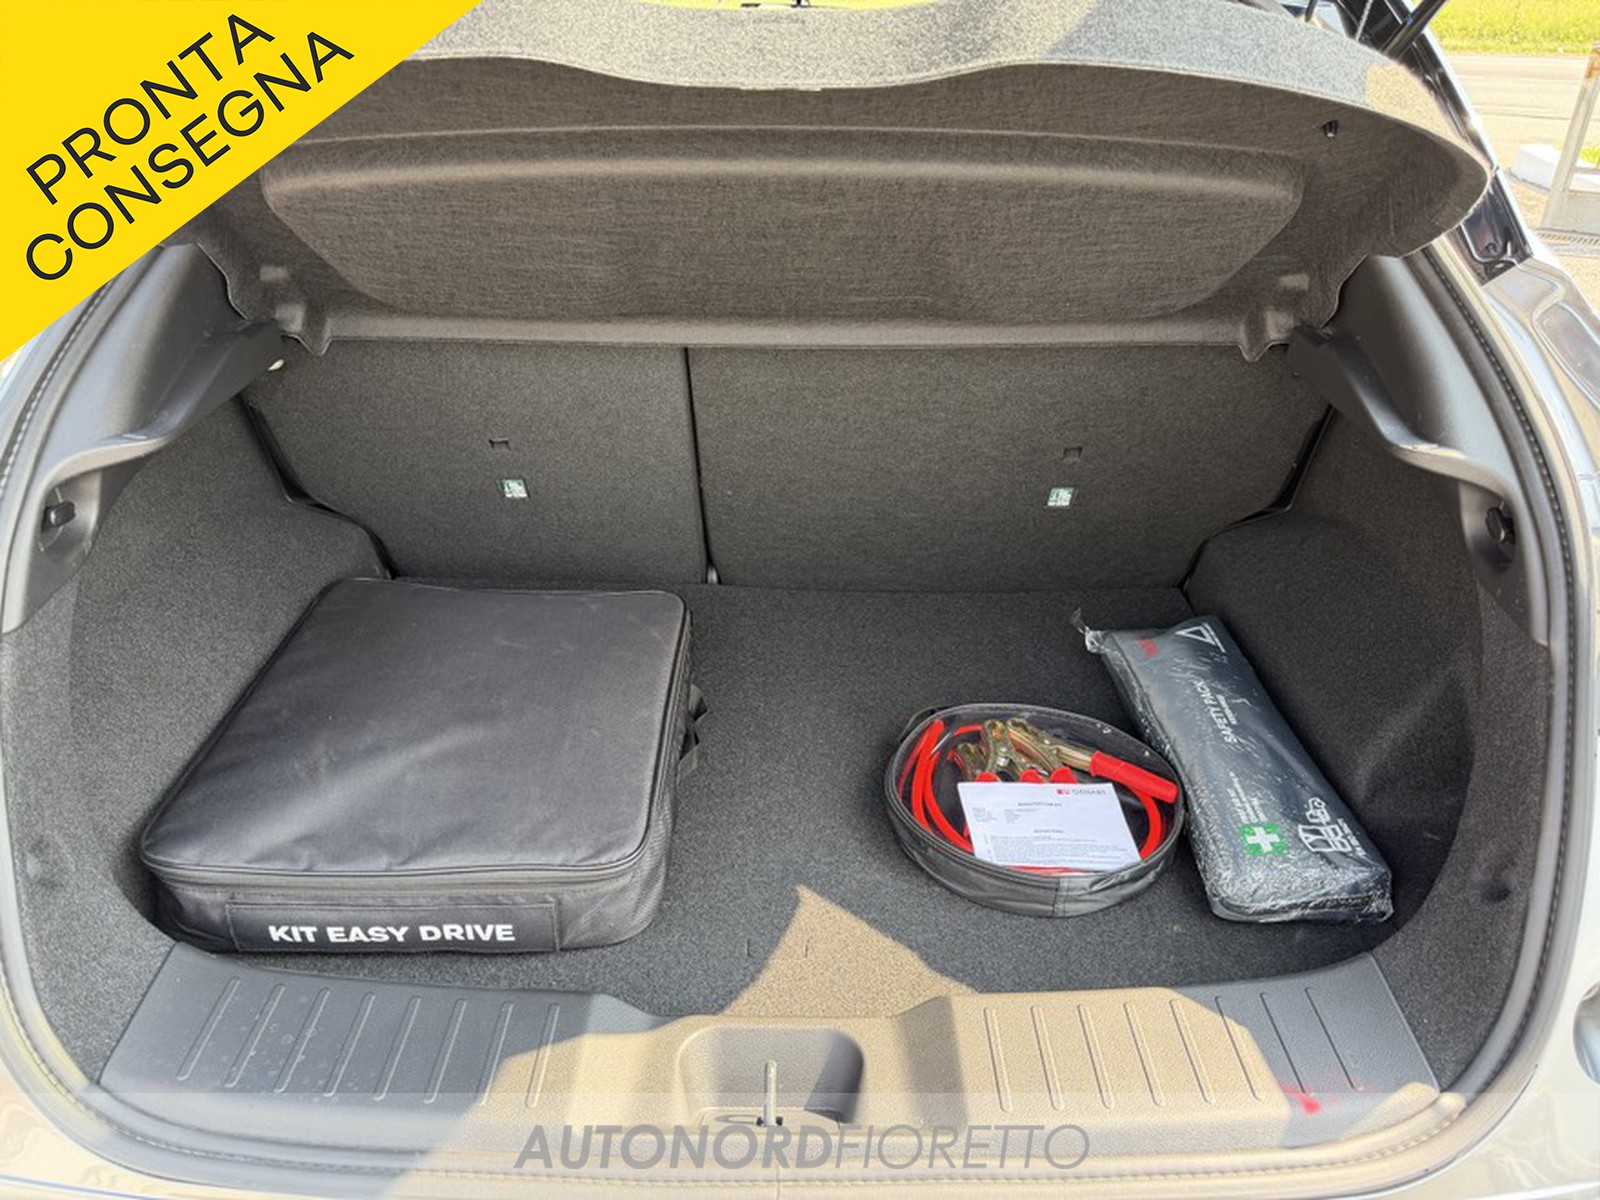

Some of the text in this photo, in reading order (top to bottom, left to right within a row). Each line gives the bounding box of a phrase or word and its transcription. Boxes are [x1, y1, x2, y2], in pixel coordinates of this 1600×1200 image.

[1206, 706, 1237, 742] SAFETY
[268, 924, 515, 943] KIT EASY DRIVE
